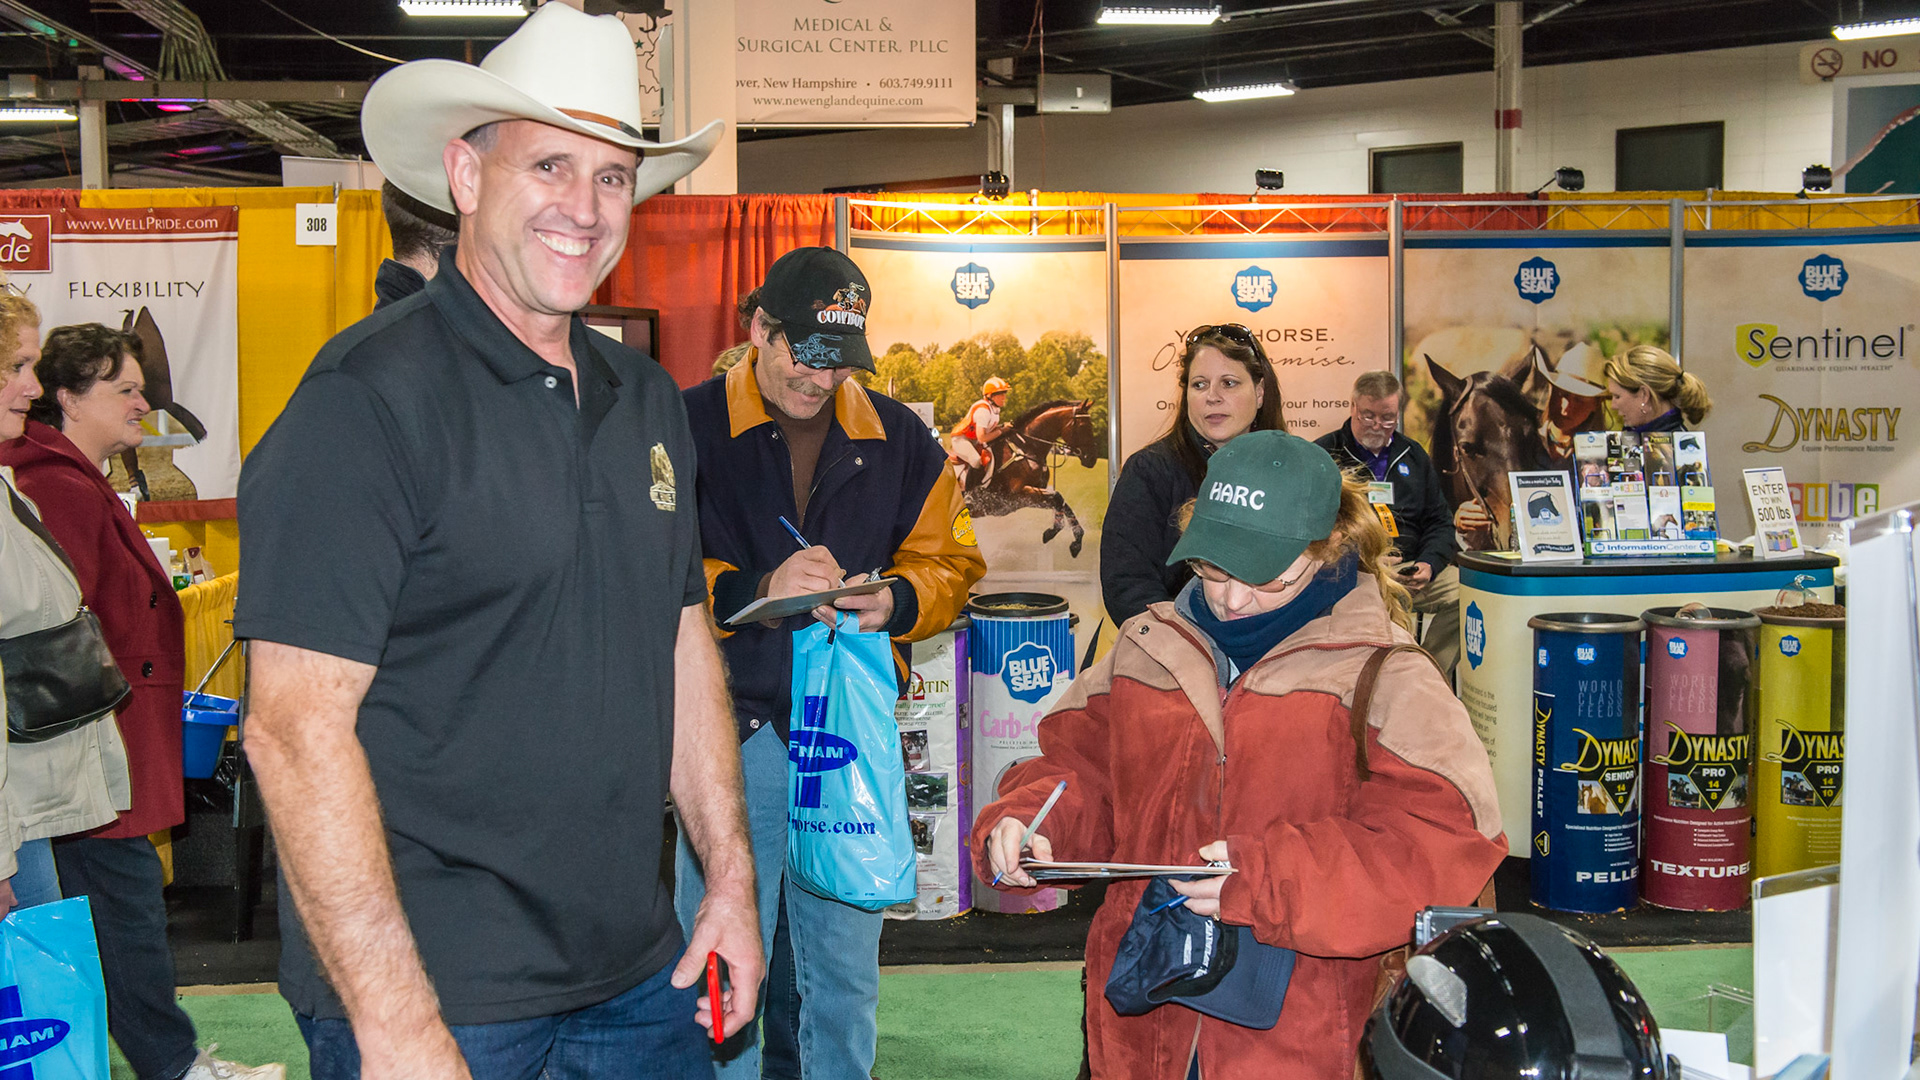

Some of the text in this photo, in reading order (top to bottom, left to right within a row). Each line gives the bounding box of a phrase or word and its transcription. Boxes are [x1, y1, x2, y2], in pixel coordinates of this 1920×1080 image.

[793, 16, 893, 32] MEDICAL &
[737, 36, 949, 53] SURGICAL CENTER, PLLC
[1862, 48, 1897, 69] NO
[763, 77, 789, 89] New
[792, 77, 857, 92] Hampshire
[879, 77, 953, 89] 603.749.9111
[753, 95, 924, 110] www.newenglandequine.com
[306, 217, 328, 232] 308
[1520, 267, 1554, 280] BLUE
[1805, 265, 1842, 278] BLUE
[956, 272, 989, 286] BLUE
[1237, 275, 1272, 289] BLUE
[1805, 278, 1842, 291] SEAL
[69, 281, 205, 299] FLEXIBILITY
[956, 286, 989, 299] SEAL
[1520, 280, 1554, 293] SEAL
[1237, 289, 1272, 302] SEAL
[1747, 326, 1905, 360] Sentinel
[1286, 418, 1320, 427] mise.
[1742, 394, 1902, 453] DYNASTY
[1209, 481, 1265, 510] HARC
[1752, 483, 1785, 496] ENTER
[1758, 506, 1791, 522] 500 lbs
[1466, 615, 1483, 638] BLUE
[1467, 634, 1483, 657] SEAL
[1009, 655, 1050, 677] BLUE
[1010, 671, 1051, 692] SEAL
[1578, 692, 1622, 705] CLASS
[1578, 704, 1622, 718] FEEDS
[1535, 698, 1552, 766] DYNASTY
[1654, 720, 1750, 766] DYNASTY
[1605, 770, 1635, 781] SENIOR
[1702, 768, 1726, 777] PRO
[1816, 765, 1840, 774] PRO
[1617, 784, 1626, 792] 14
[1708, 780, 1720, 788] 14
[1822, 777, 1834, 785] 14
[1617, 796, 1624, 804] 6
[1710, 792, 1718, 800] 8
[1822, 789, 1834, 797] 10
